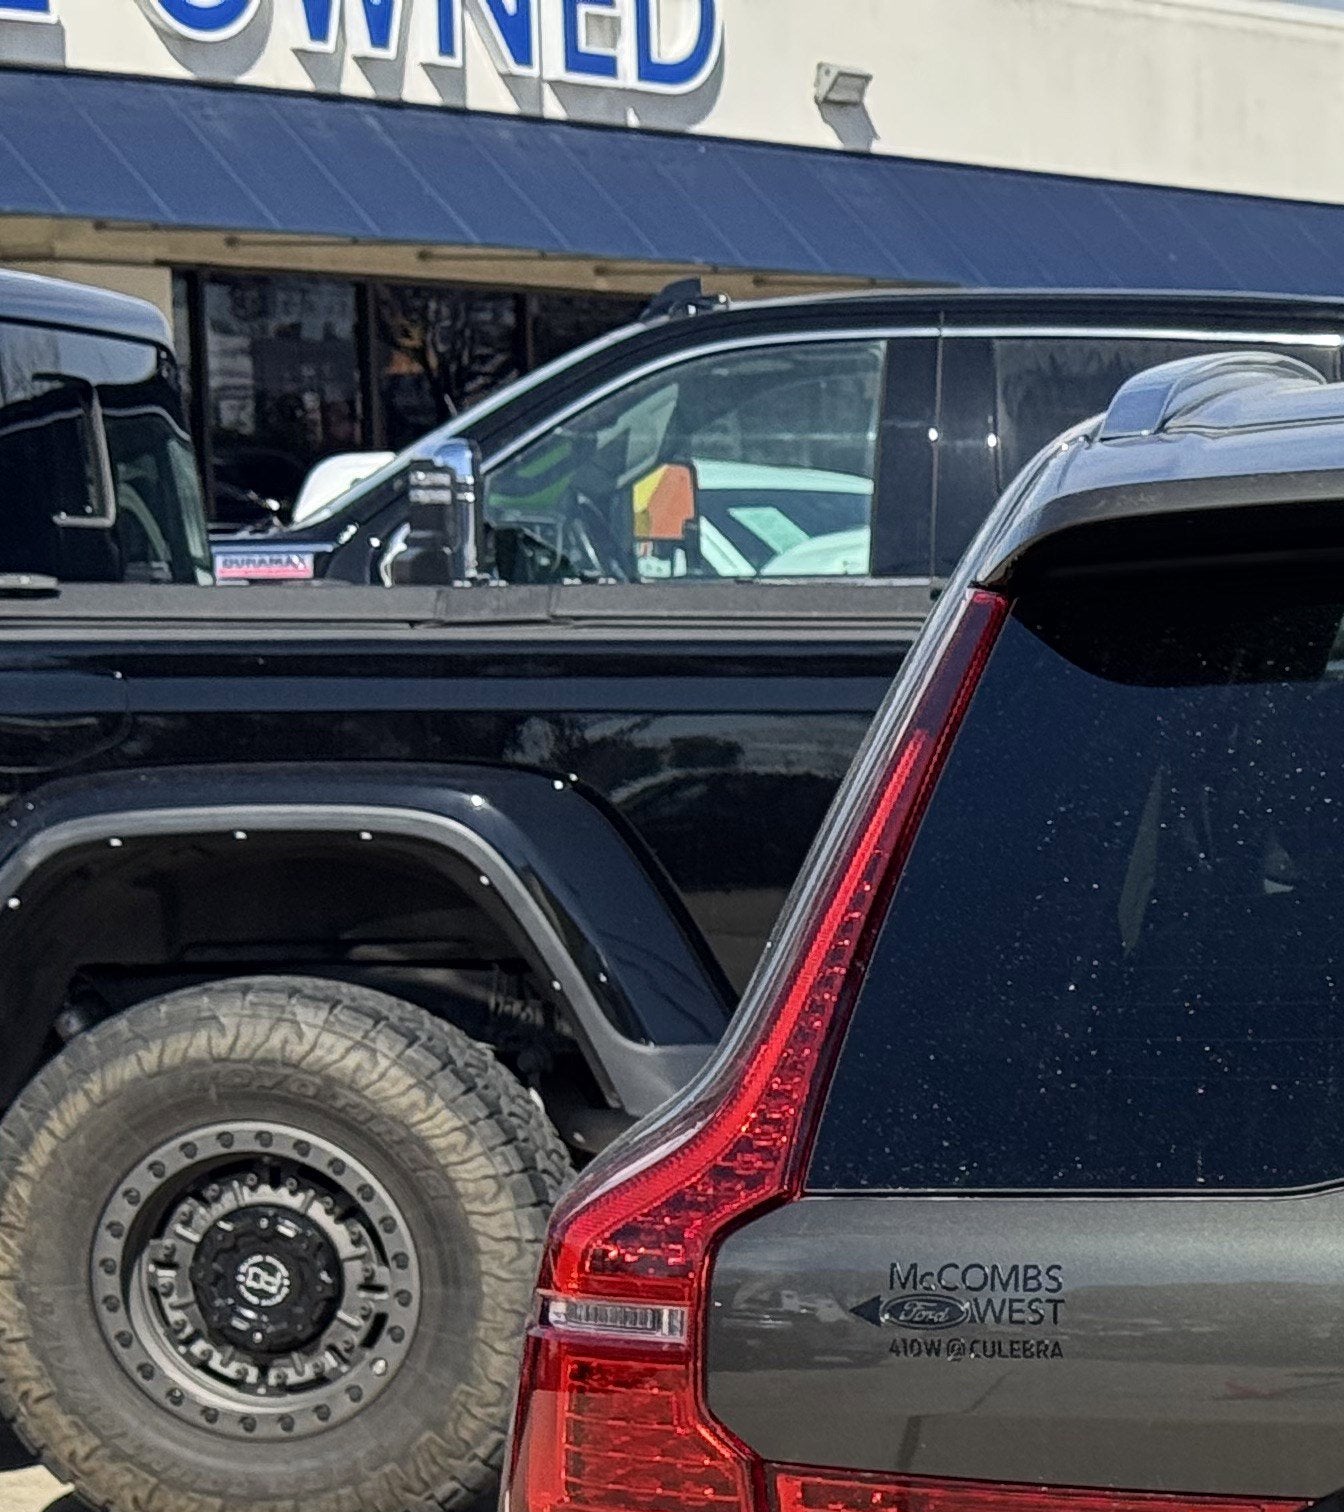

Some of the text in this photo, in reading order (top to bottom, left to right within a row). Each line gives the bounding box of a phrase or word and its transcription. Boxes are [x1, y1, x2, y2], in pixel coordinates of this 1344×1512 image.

[152, 0, 722, 95] NED
[889, 1262, 1064, 1293] McCOMBS
[899, 1298, 1066, 1325] Ford WEST
[969, 1339, 1064, 1359] CULEBRA
